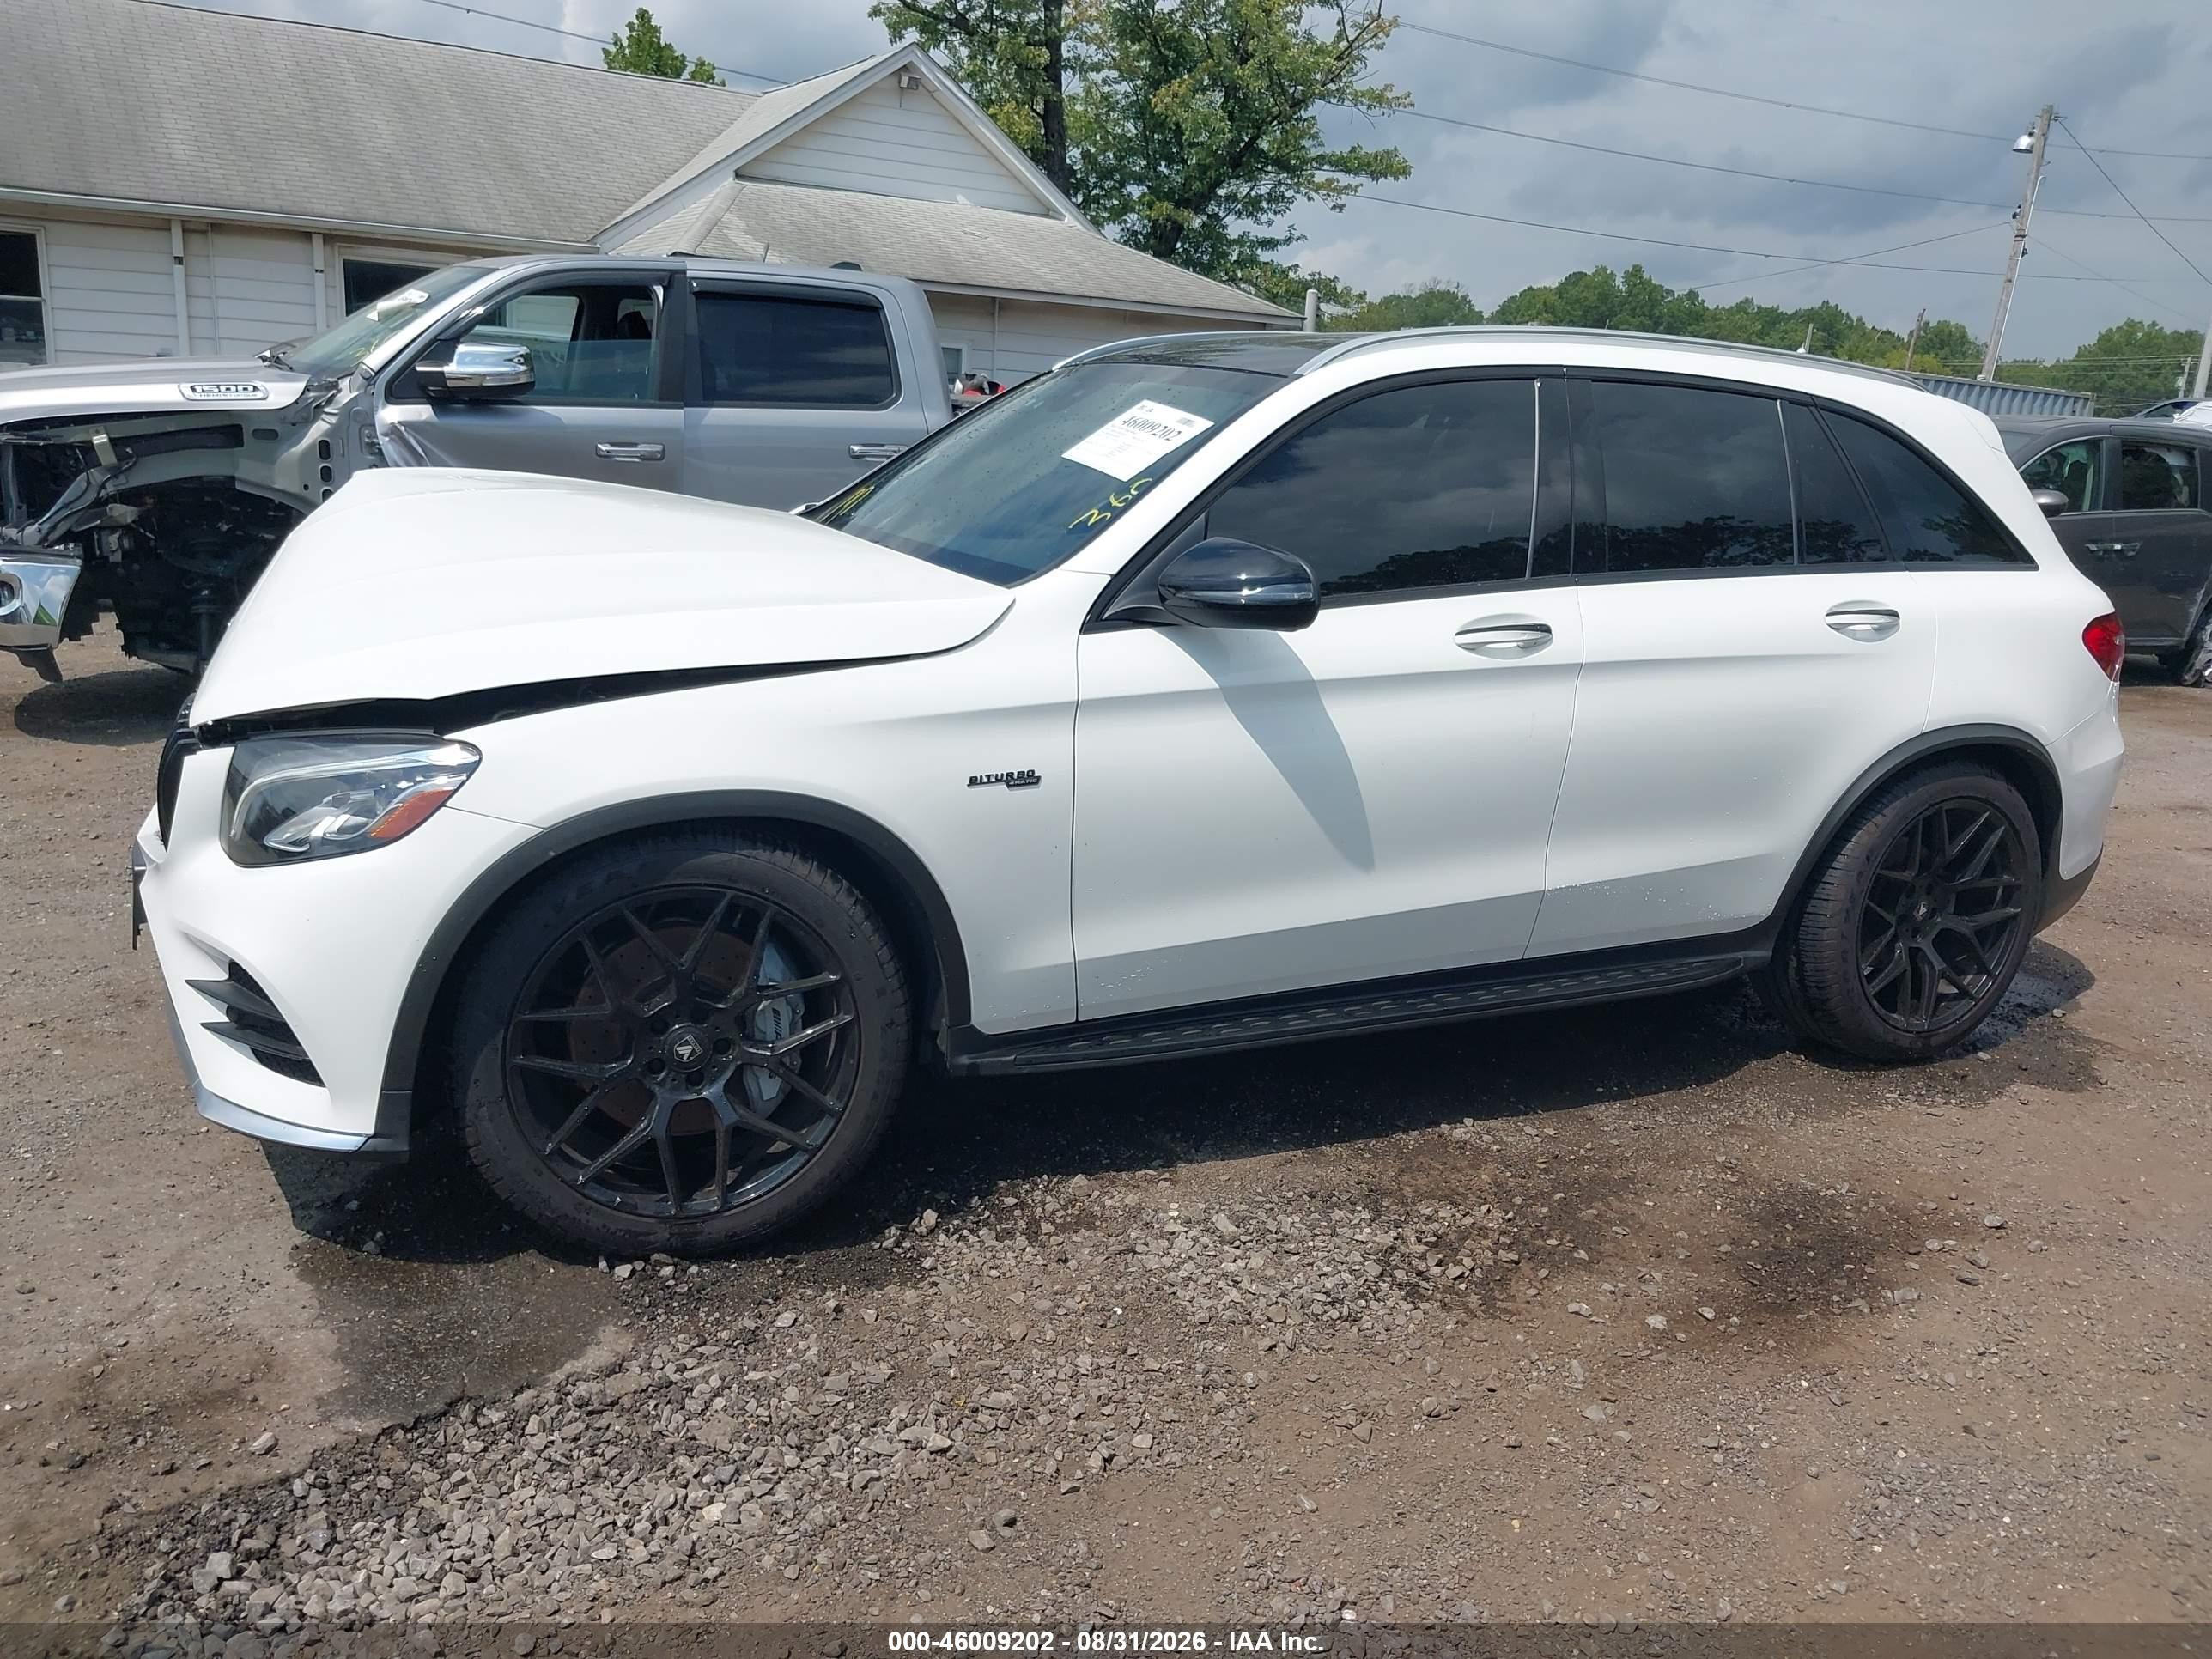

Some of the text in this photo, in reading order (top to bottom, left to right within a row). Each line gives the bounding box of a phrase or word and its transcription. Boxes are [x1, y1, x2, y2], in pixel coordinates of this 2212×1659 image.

[191, 385, 255, 393] 1500
[1121, 416, 1182, 441] 46009202
[969, 769, 1036, 785] BITURBO
